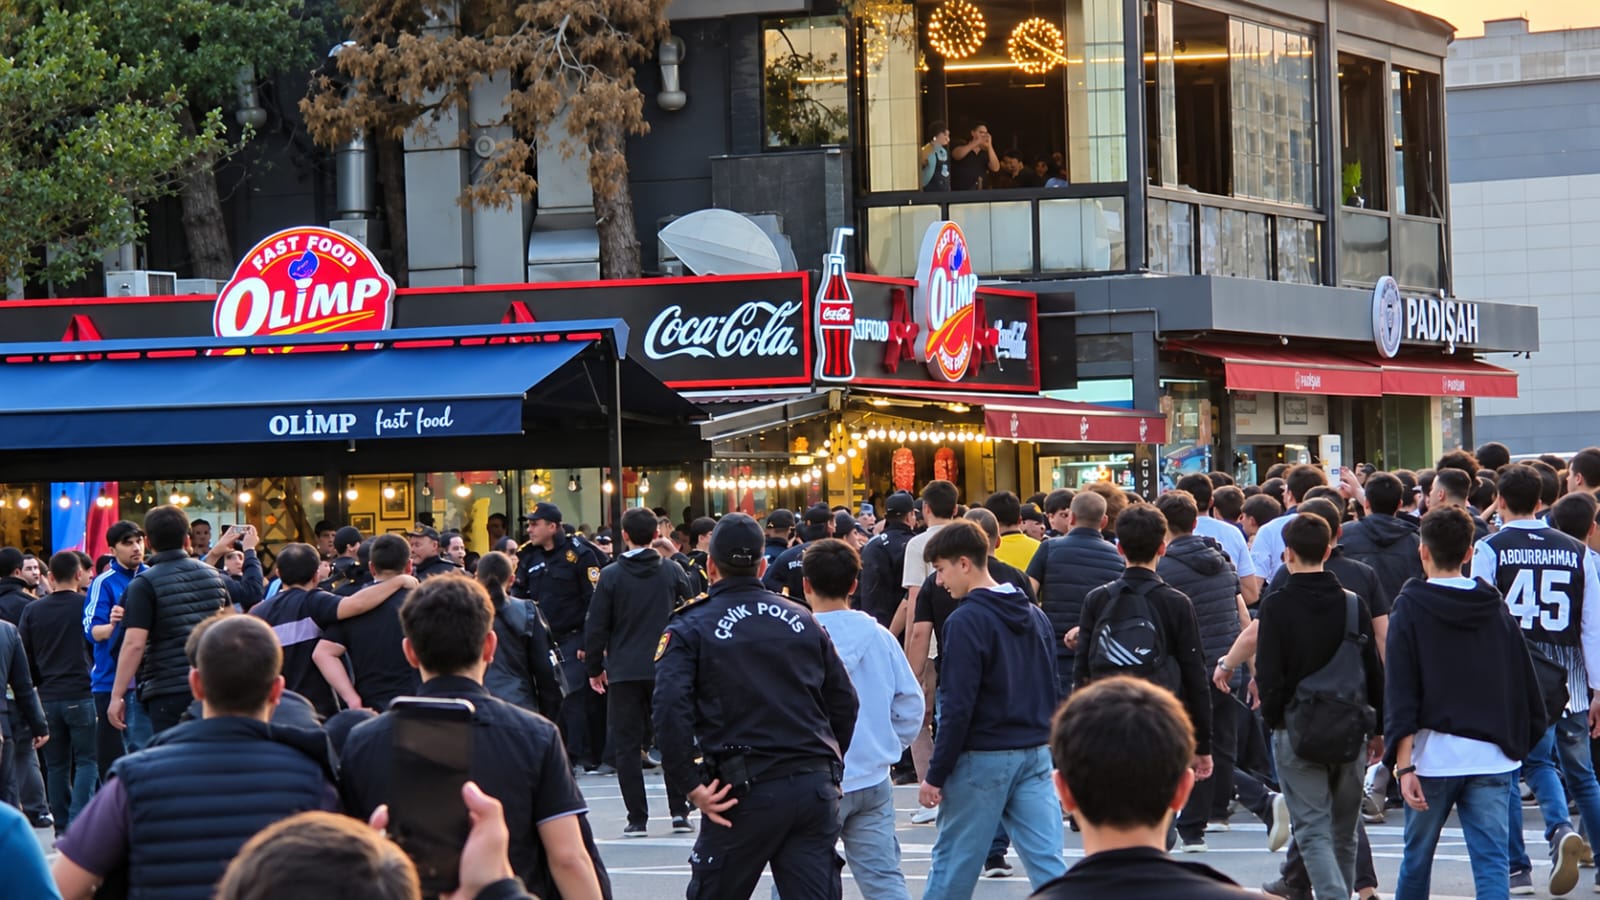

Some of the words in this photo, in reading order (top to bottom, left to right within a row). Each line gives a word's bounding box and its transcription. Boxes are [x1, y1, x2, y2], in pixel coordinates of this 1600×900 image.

[252, 235, 299, 270] FAST
[306, 235, 357, 267] FOOD
[268, 408, 357, 436] OLİMP
[375, 407, 413, 436] fast
[416, 404, 454, 435] food
[1504, 568, 1571, 632] 45
[714, 603, 752, 640] ÇEVİK
[757, 601, 805, 633] POLİS
